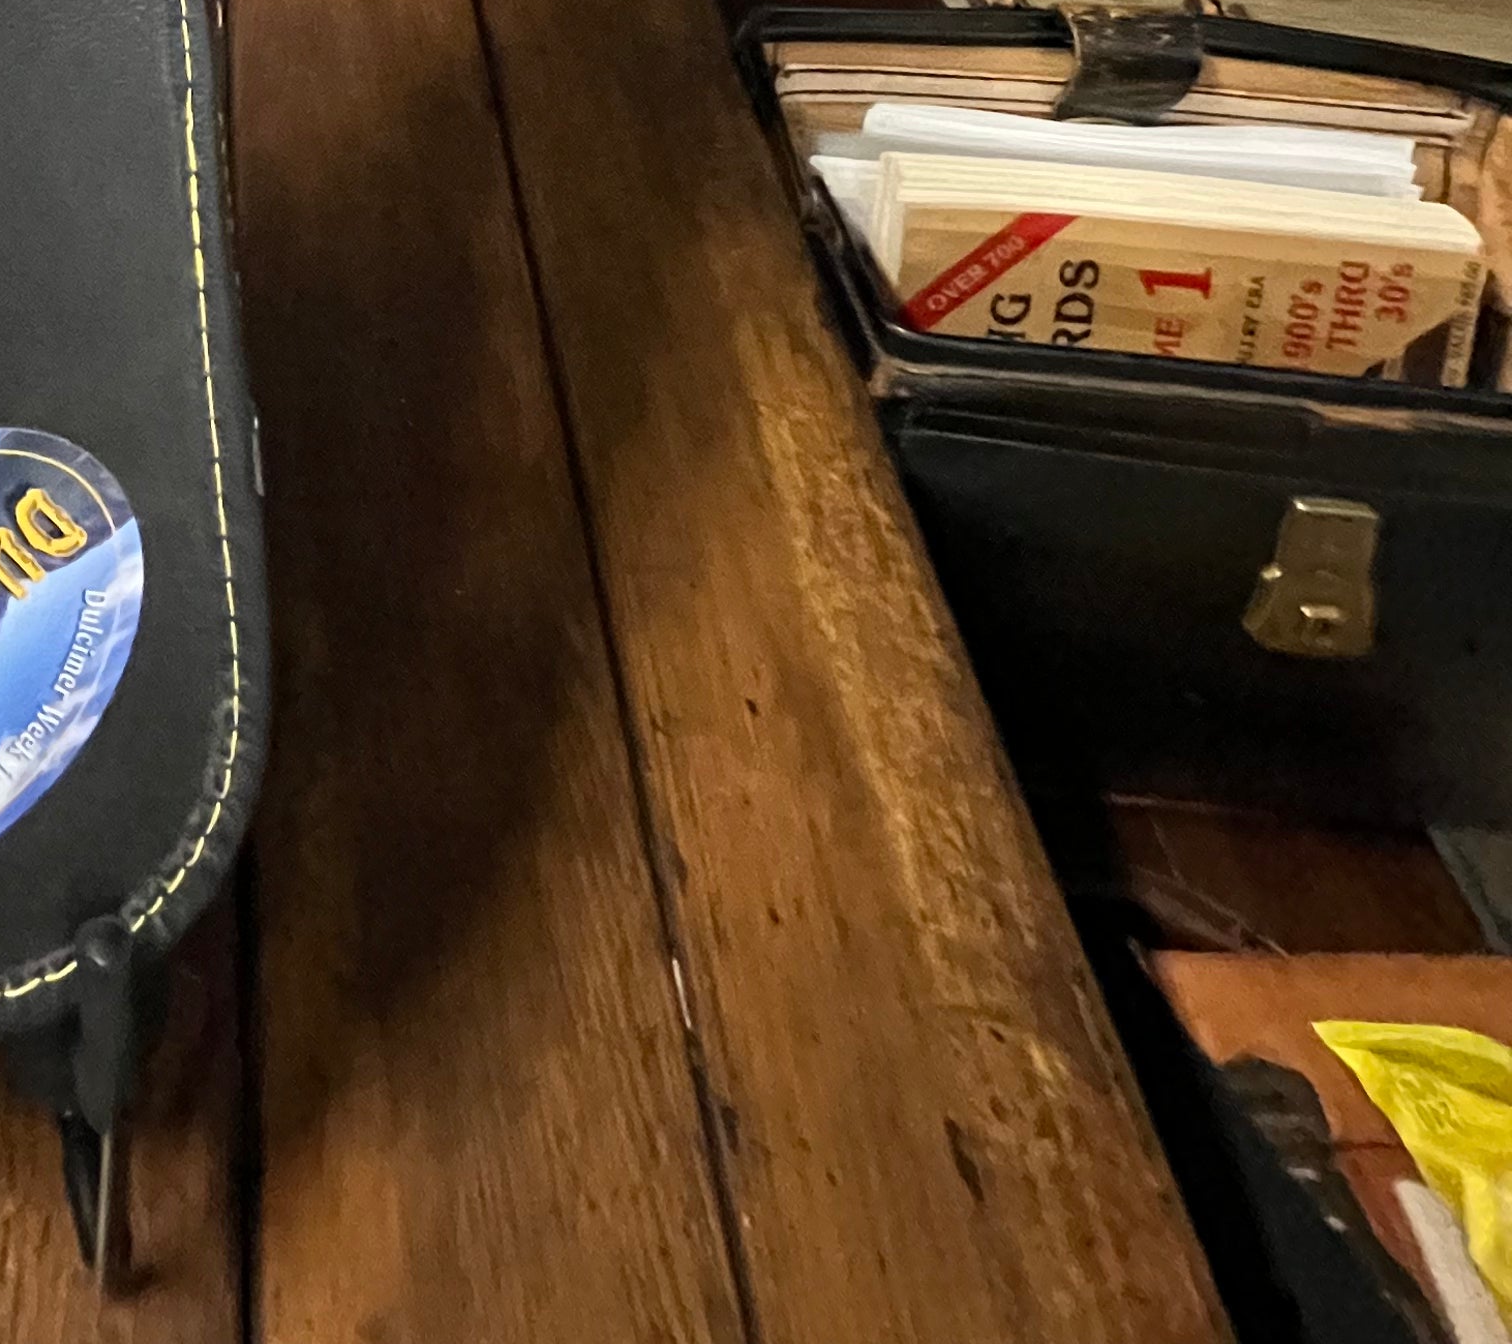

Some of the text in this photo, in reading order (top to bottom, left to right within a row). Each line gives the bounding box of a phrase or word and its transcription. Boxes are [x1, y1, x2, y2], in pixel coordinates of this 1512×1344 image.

[925, 233, 1025, 313] OVER 700
[1138, 266, 1213, 301] 1
[52, 587, 108, 700] Dulcimer
[8, 703, 65, 761] Week
